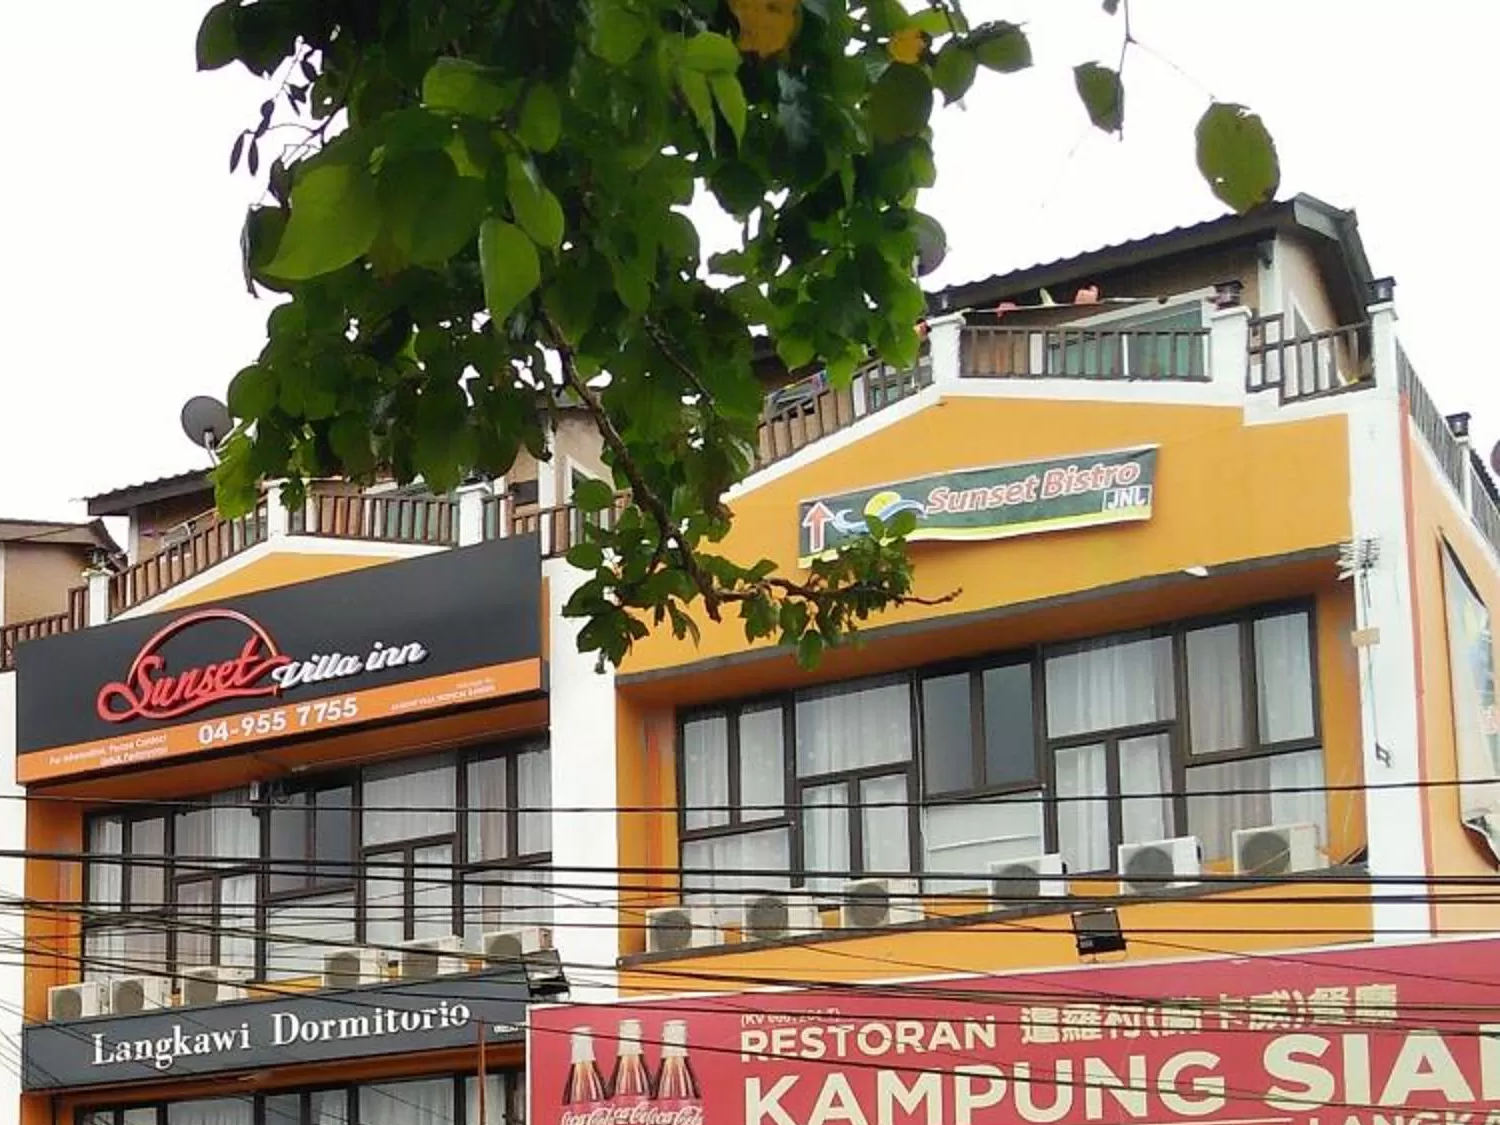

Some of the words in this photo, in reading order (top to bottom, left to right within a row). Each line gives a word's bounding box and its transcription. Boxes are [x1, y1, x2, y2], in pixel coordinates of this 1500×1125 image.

[926, 478, 1040, 515] Sunset
[1041, 459, 1142, 499] Bistro
[97, 637, 292, 723] Sunset
[365, 640, 427, 672] inn
[199, 711, 287, 745] 04-955
[296, 698, 359, 727] 7755
[92, 1022, 251, 1071] Langkawi
[271, 1000, 471, 1047] Dormitorio
[740, 1015, 996, 1063] RESTORAN
